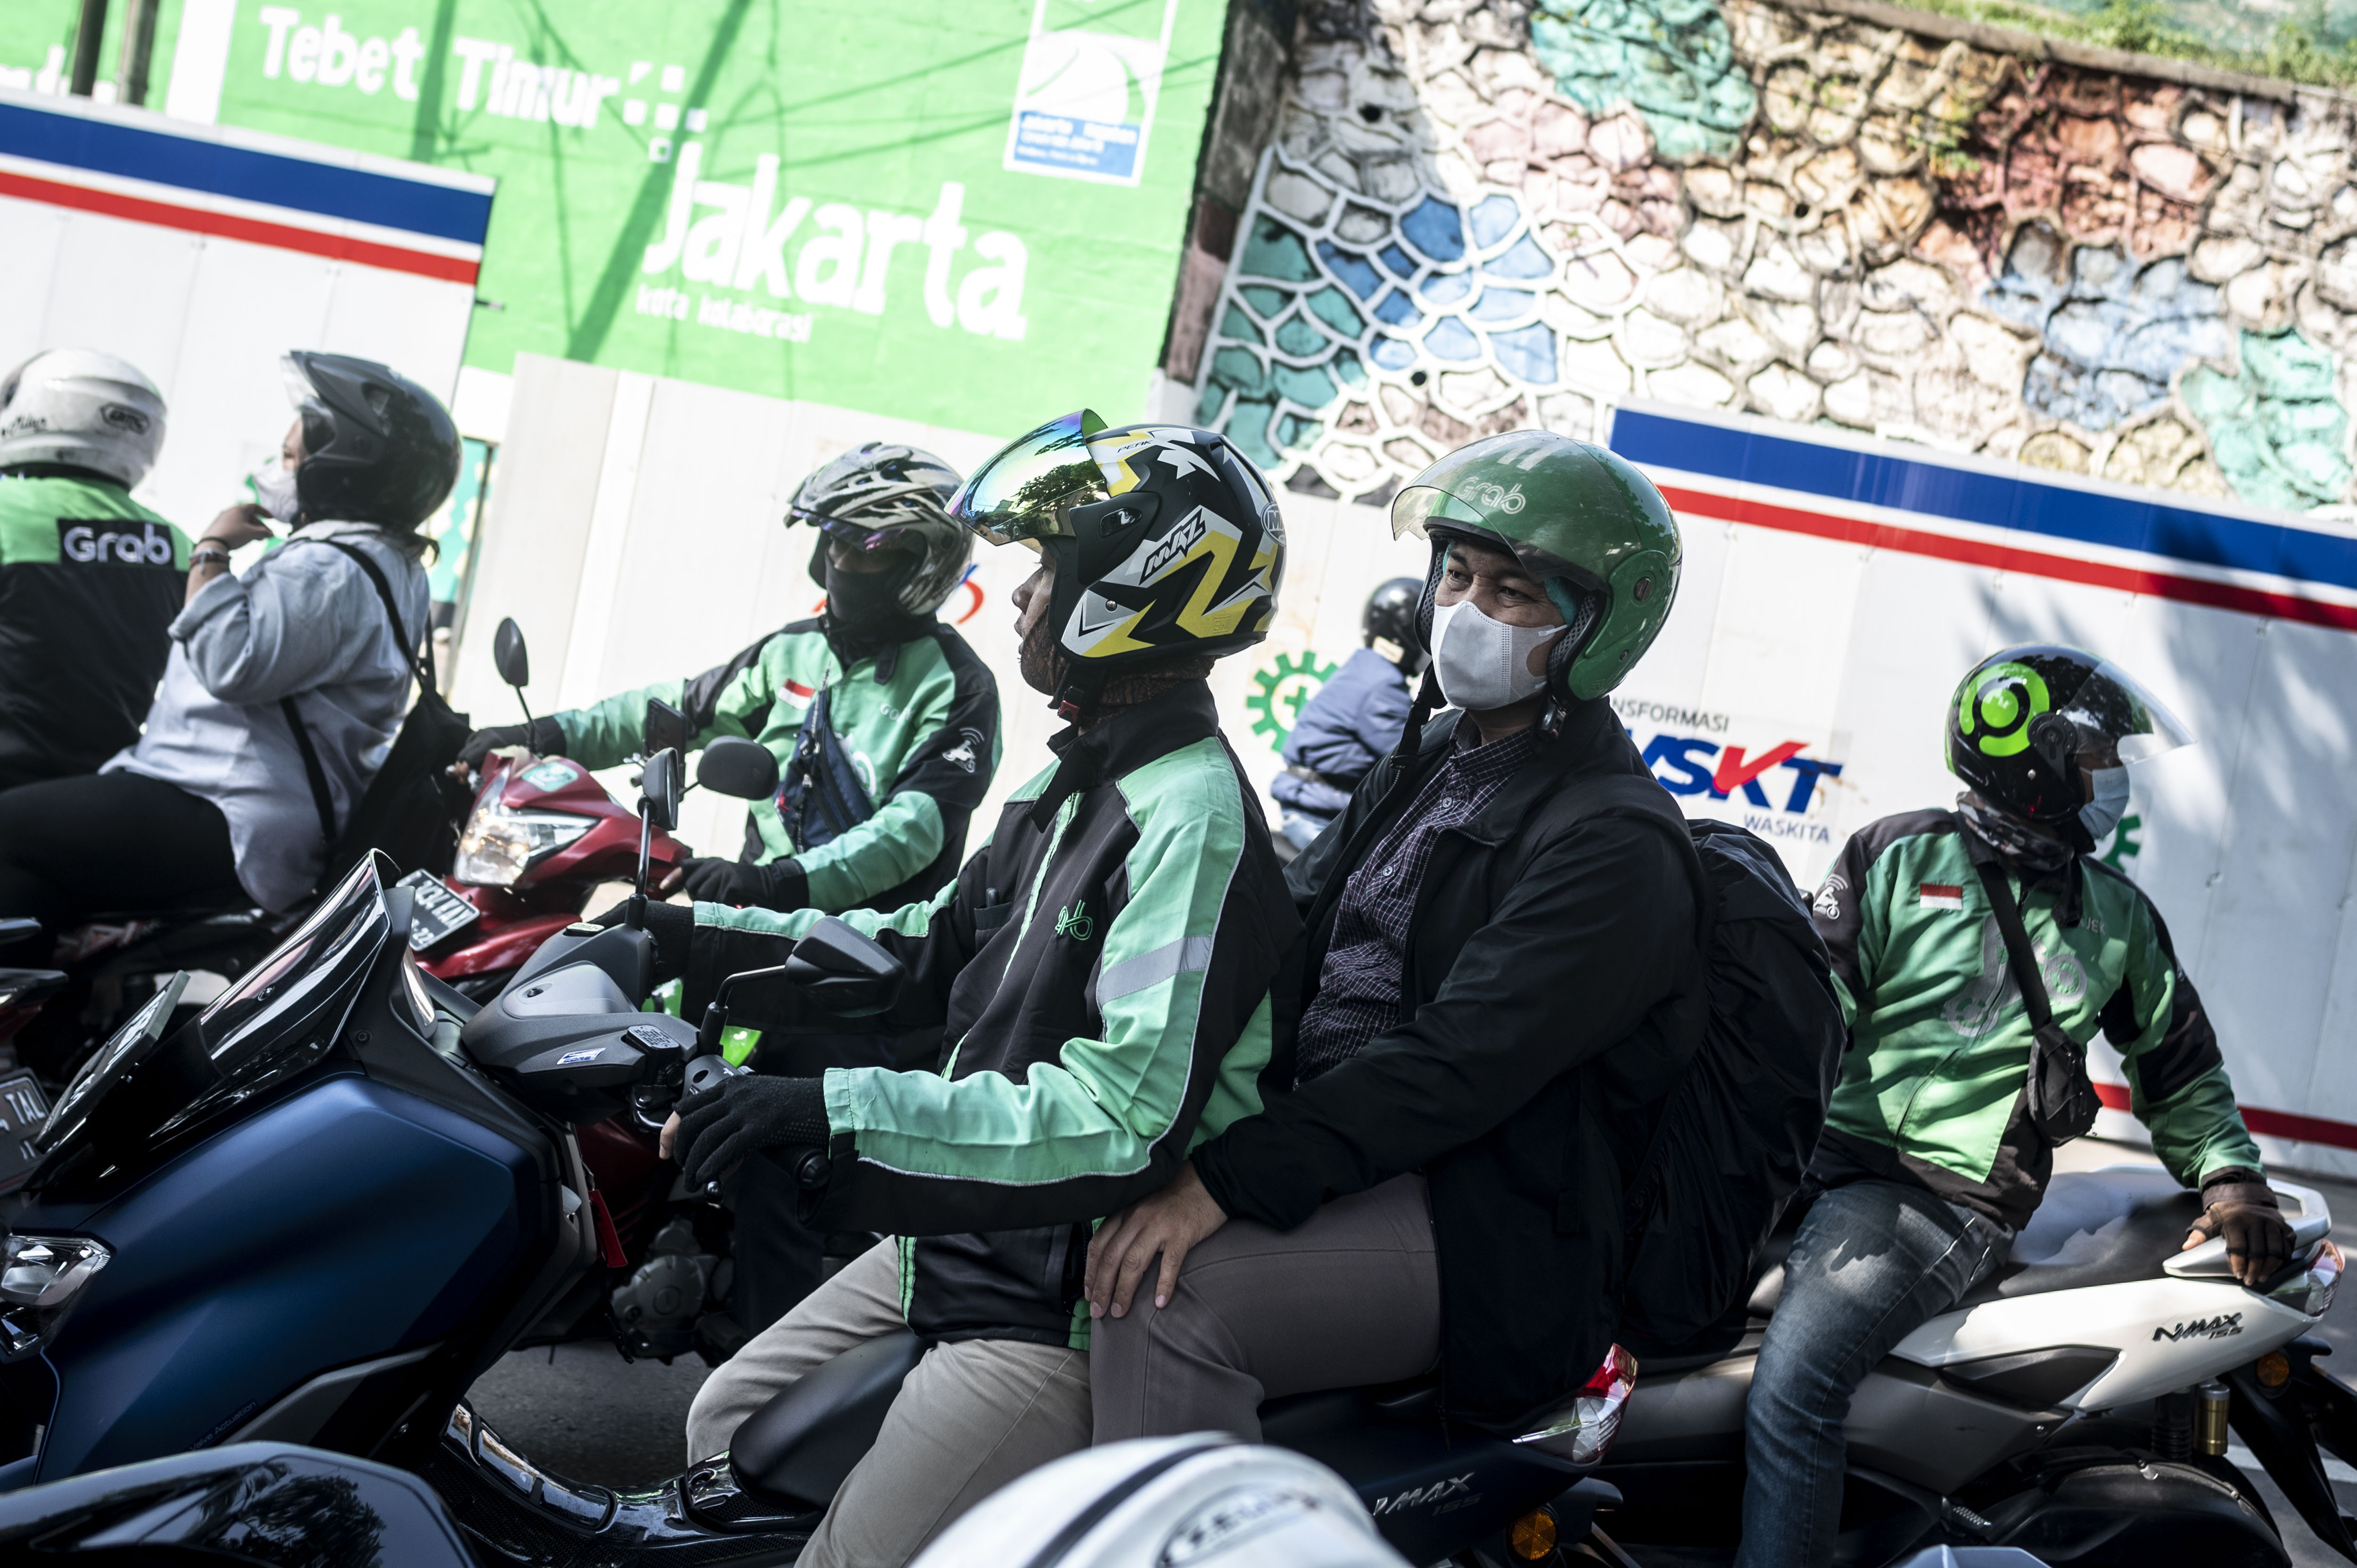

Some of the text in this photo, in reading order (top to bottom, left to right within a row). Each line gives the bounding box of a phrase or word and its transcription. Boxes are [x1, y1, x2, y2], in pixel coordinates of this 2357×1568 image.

[259, 5, 620, 129] Tebet Timur
[642, 141, 1028, 341] Jakarta
[1454, 476, 1526, 514] Grab
[64, 523, 171, 564] Grab
[1612, 698, 1730, 732] NSFORMASI
[1743, 813, 1830, 845] WASKITA
[190, 1401, 256, 1451] Valve Actuation
[1432, 1493, 1483, 1517] 155
